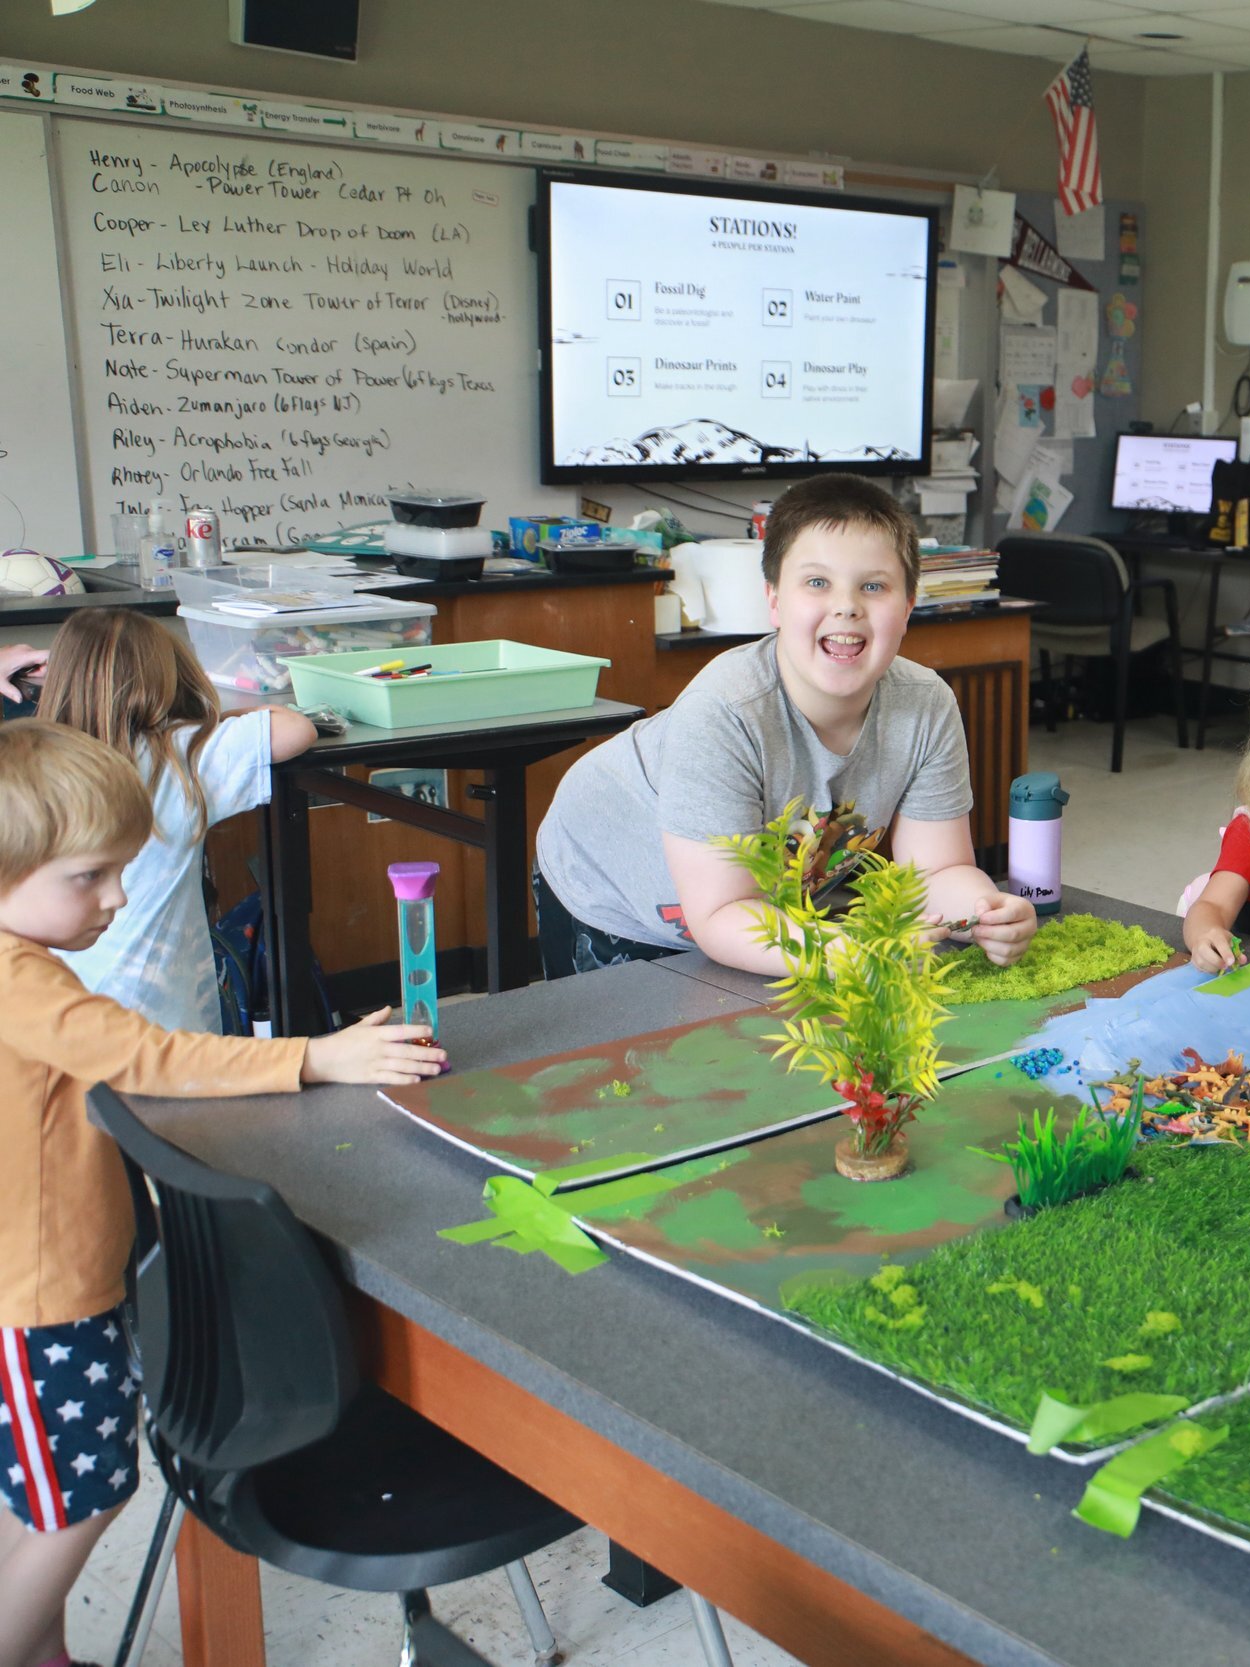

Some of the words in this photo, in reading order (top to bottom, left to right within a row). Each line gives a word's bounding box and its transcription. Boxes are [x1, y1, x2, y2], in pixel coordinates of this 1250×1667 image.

[71, 85, 93, 96] Food
[95, 87, 116, 98] Web
[169, 100, 227, 115] Photosynthesis
[265, 111, 291, 123] Energy
[292, 114, 321, 124] Transfer
[90, 150, 142, 177] Henry
[92, 173, 159, 195] Canon
[268, 181, 320, 199] Tower
[339, 183, 385, 202] Cedar
[224, 216, 287, 235] Luther
[297, 221, 342, 241] Drop
[350, 224, 369, 239] of
[377, 225, 416, 240] Doom
[709, 215, 797, 239] STATIONS!
[101, 253, 130, 272] Eli
[156, 252, 225, 279] Liberty
[236, 255, 303, 273] Launch
[327, 256, 388, 281] Holiday
[403, 258, 453, 279] World
[147, 286, 230, 314] Twilight
[303, 292, 361, 310] Tower
[367, 292, 380, 310] of
[385, 292, 430, 310] Terror
[655, 281, 685, 295] Fossil
[687, 283, 706, 300] Dig
[804, 290, 834, 304] Water
[836, 291, 861, 305] Paint
[614, 292, 632, 309] 01
[768, 300, 788, 316] 02
[180, 329, 258, 351] Hurakan
[166, 358, 267, 386] Superman
[271, 368, 320, 387] Tower
[326, 368, 342, 387] of
[352, 368, 401, 387] Power
[655, 357, 703, 371] Dinosaur
[705, 358, 737, 372] Prints
[803, 361, 846, 374] Dinosaur
[848, 362, 868, 377] Play
[613, 368, 635, 387] 03
[765, 372, 787, 388] 04
[178, 396, 266, 420] Zumanjaro
[173, 426, 272, 455] Acrophobia
[180, 462, 243, 483] Orlando
[222, 496, 274, 523] Hopper
[560, 526, 588, 539] Ziploc
[1020, 886, 1034, 899] Lily
